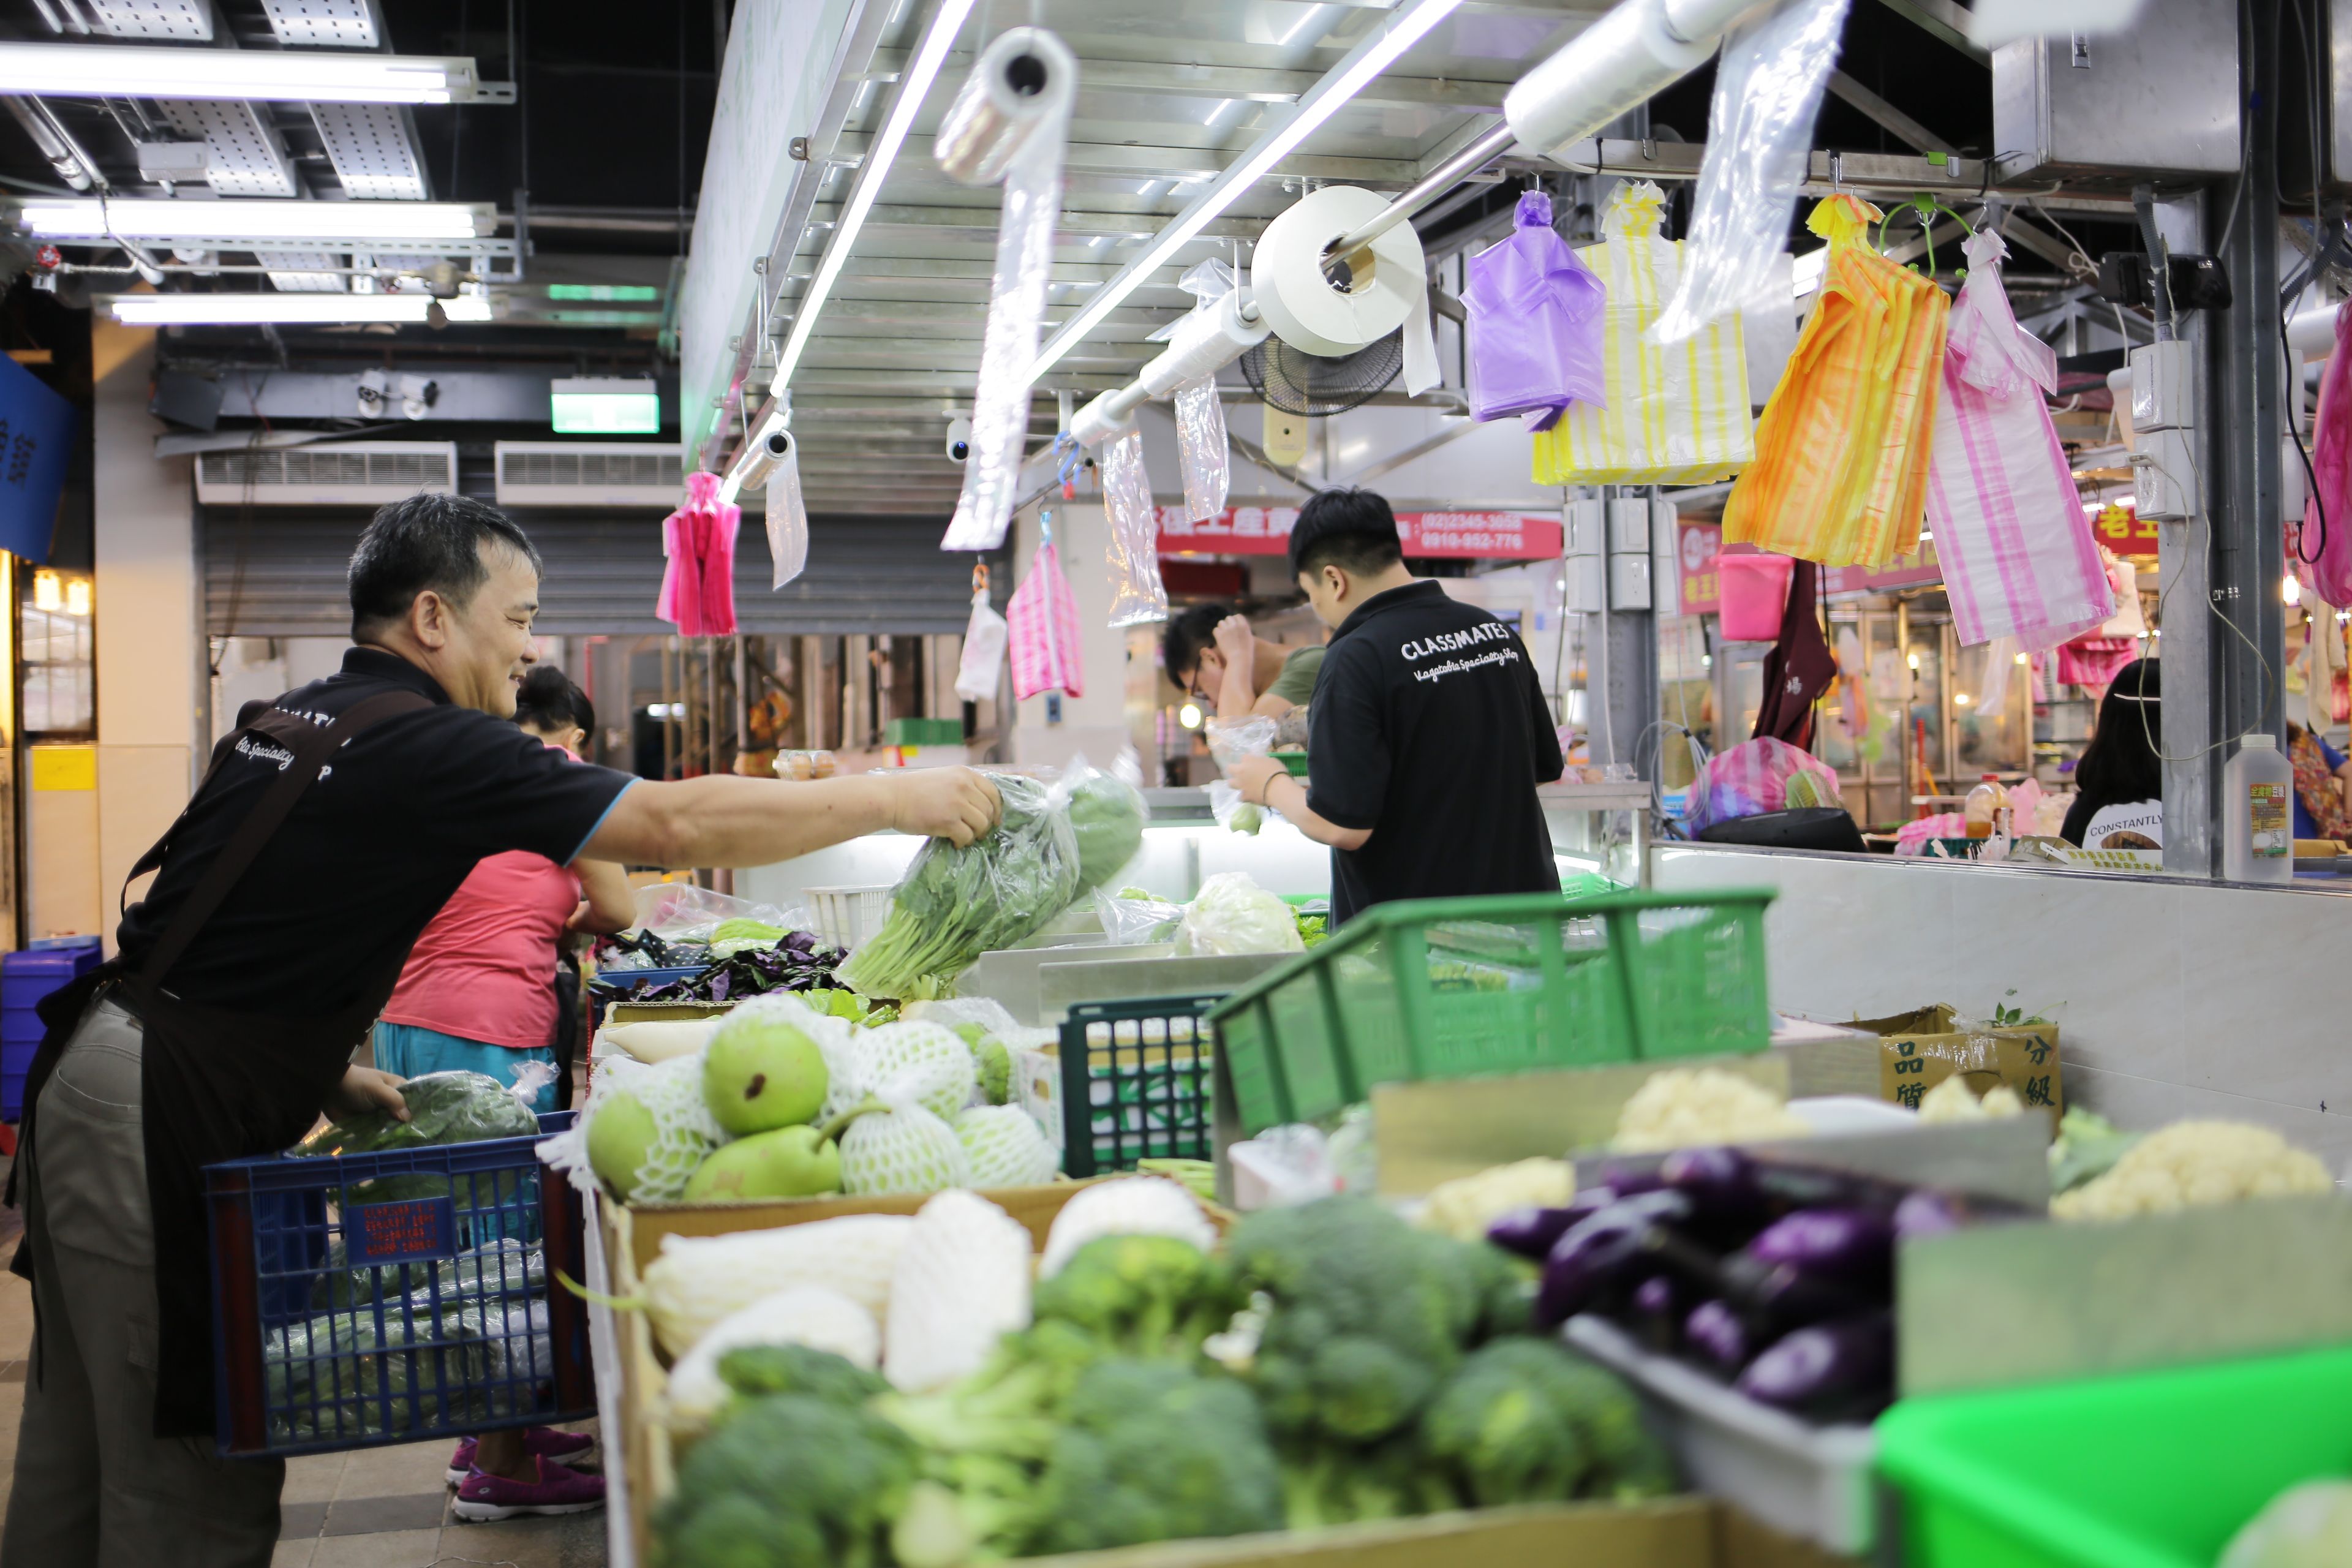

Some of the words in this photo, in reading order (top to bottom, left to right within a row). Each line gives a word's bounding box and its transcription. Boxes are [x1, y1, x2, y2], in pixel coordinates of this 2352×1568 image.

[1401, 622, 1510, 660] CLASSMATES
[1414, 660, 1461, 682] Vegetable
[1460, 650, 1504, 672] Specialty
[248, 742, 295, 771] Specialty
[1894, 1041, 1927, 1112] 品質
[2024, 1036, 2056, 1107] 分級
